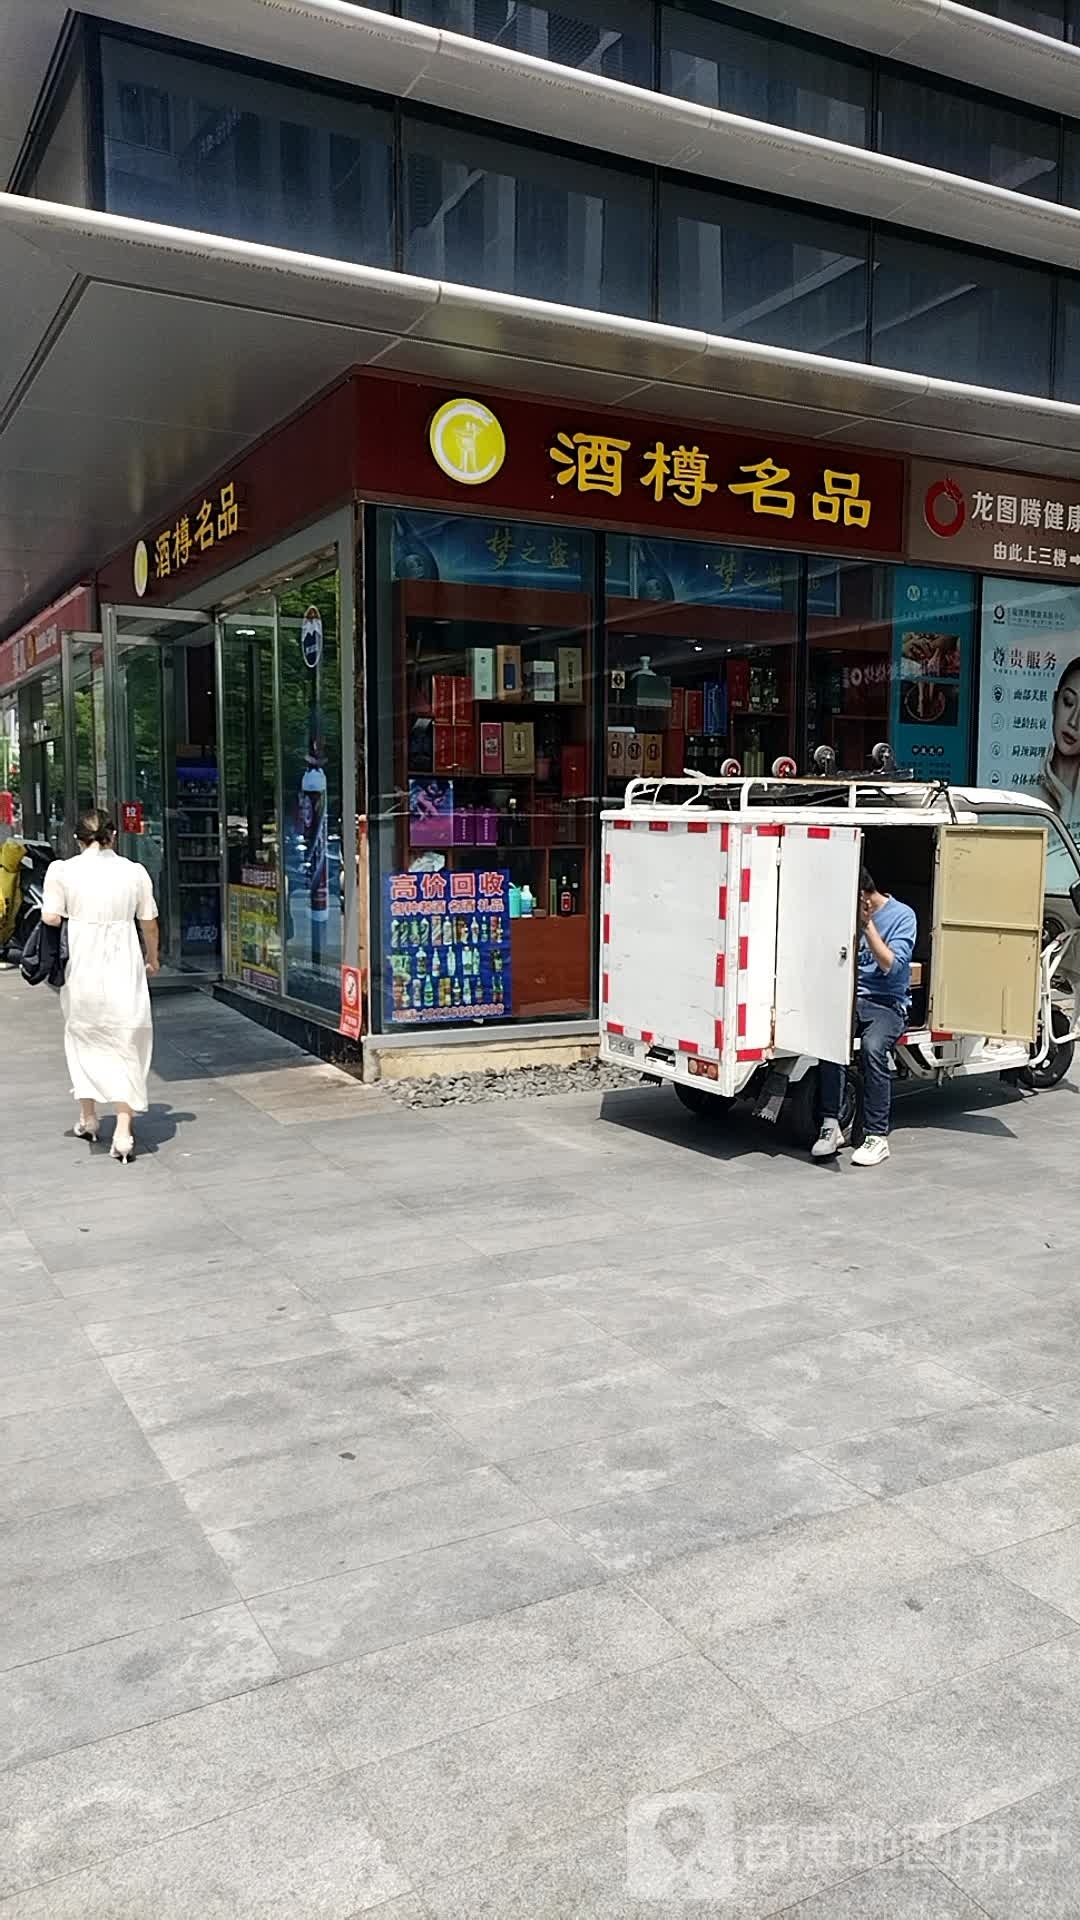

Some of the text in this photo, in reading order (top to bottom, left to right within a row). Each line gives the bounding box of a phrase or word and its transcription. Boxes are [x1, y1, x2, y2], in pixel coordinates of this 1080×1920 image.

[549, 431, 872, 530] 酒樽名品
[154, 481, 239, 579] 酒樽名品
[993, 542, 1067, 568] 由此上三楼
[992, 645, 1057, 671] 尊贵服务
[390, 872, 505, 900] 高价回收
[477, 898, 505, 912] 礼品
